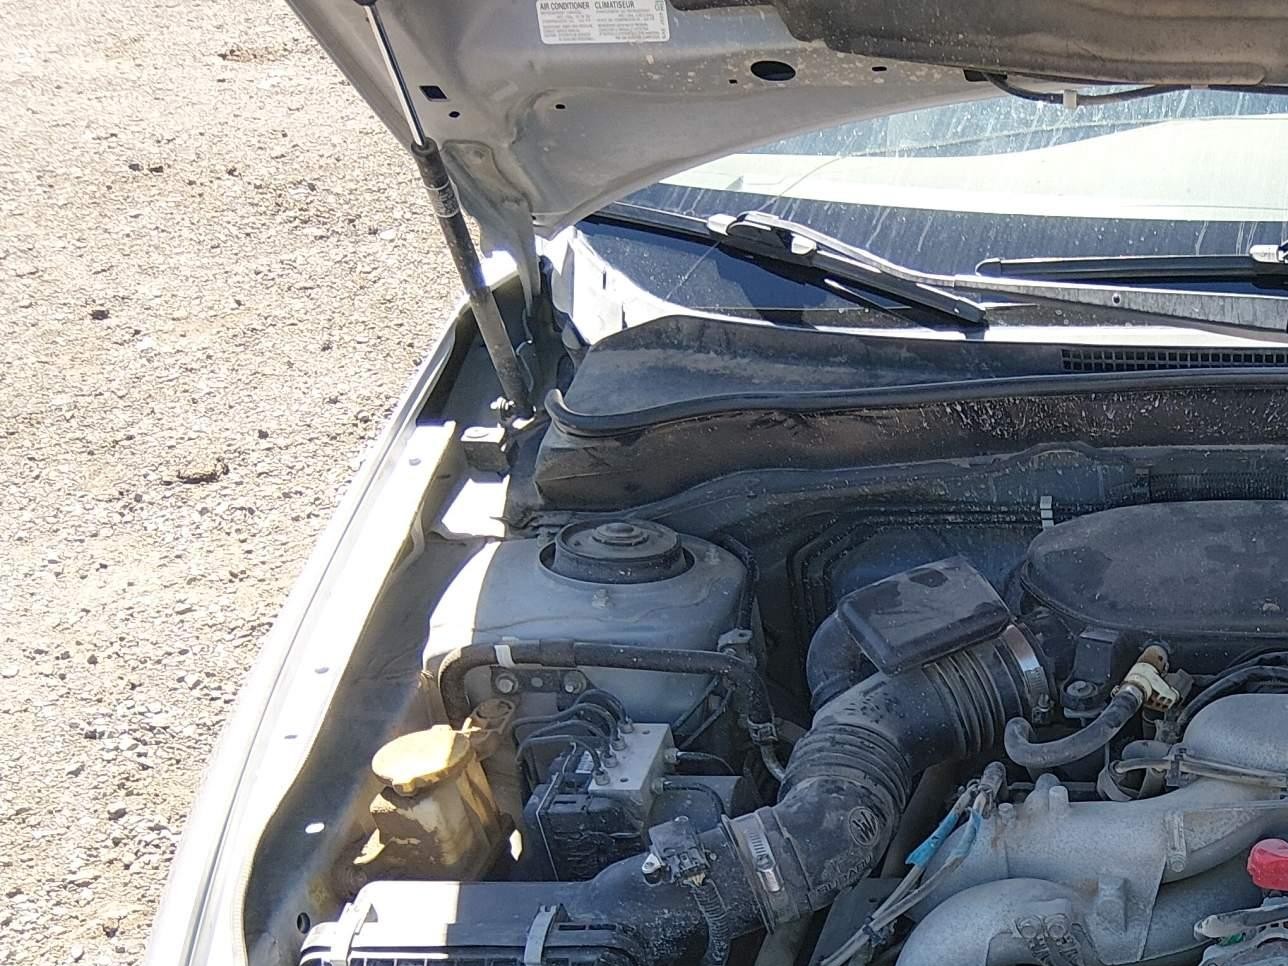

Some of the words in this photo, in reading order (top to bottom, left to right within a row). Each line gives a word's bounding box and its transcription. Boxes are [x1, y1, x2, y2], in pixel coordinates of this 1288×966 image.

[540, 2, 549, 10] AIR
[551, 1, 590, 10] CONDITIONER
[594, 1, 635, 9] CLIMATISEUR
